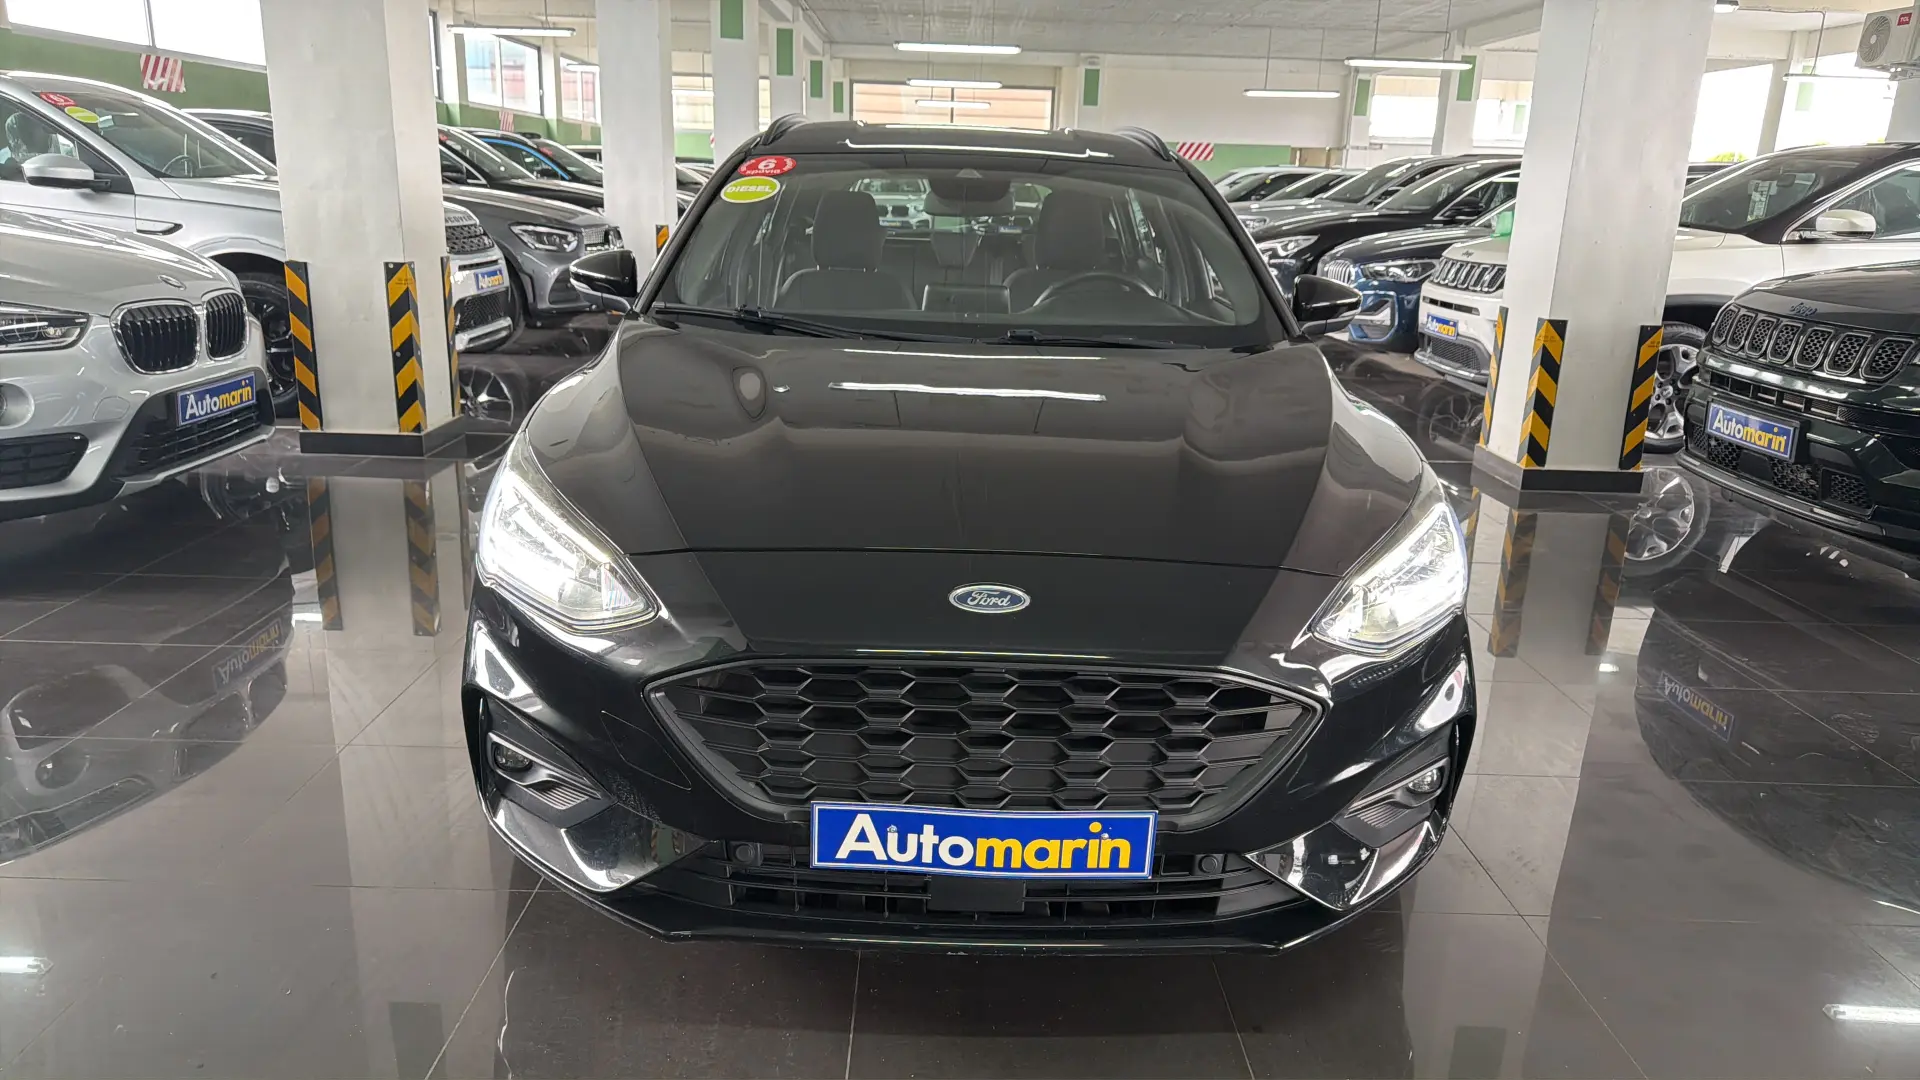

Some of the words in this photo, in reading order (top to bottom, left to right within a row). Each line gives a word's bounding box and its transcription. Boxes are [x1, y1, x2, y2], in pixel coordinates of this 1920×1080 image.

[758, 158, 777, 170] 6
[726, 185, 772, 193] DIESEL
[1789, 302, 1818, 317] Jeep
[185, 380, 252, 420] Automarin
[1712, 409, 1787, 452] Automarin
[967, 590, 1012, 606] Ford
[835, 813, 1131, 869] Automarin
